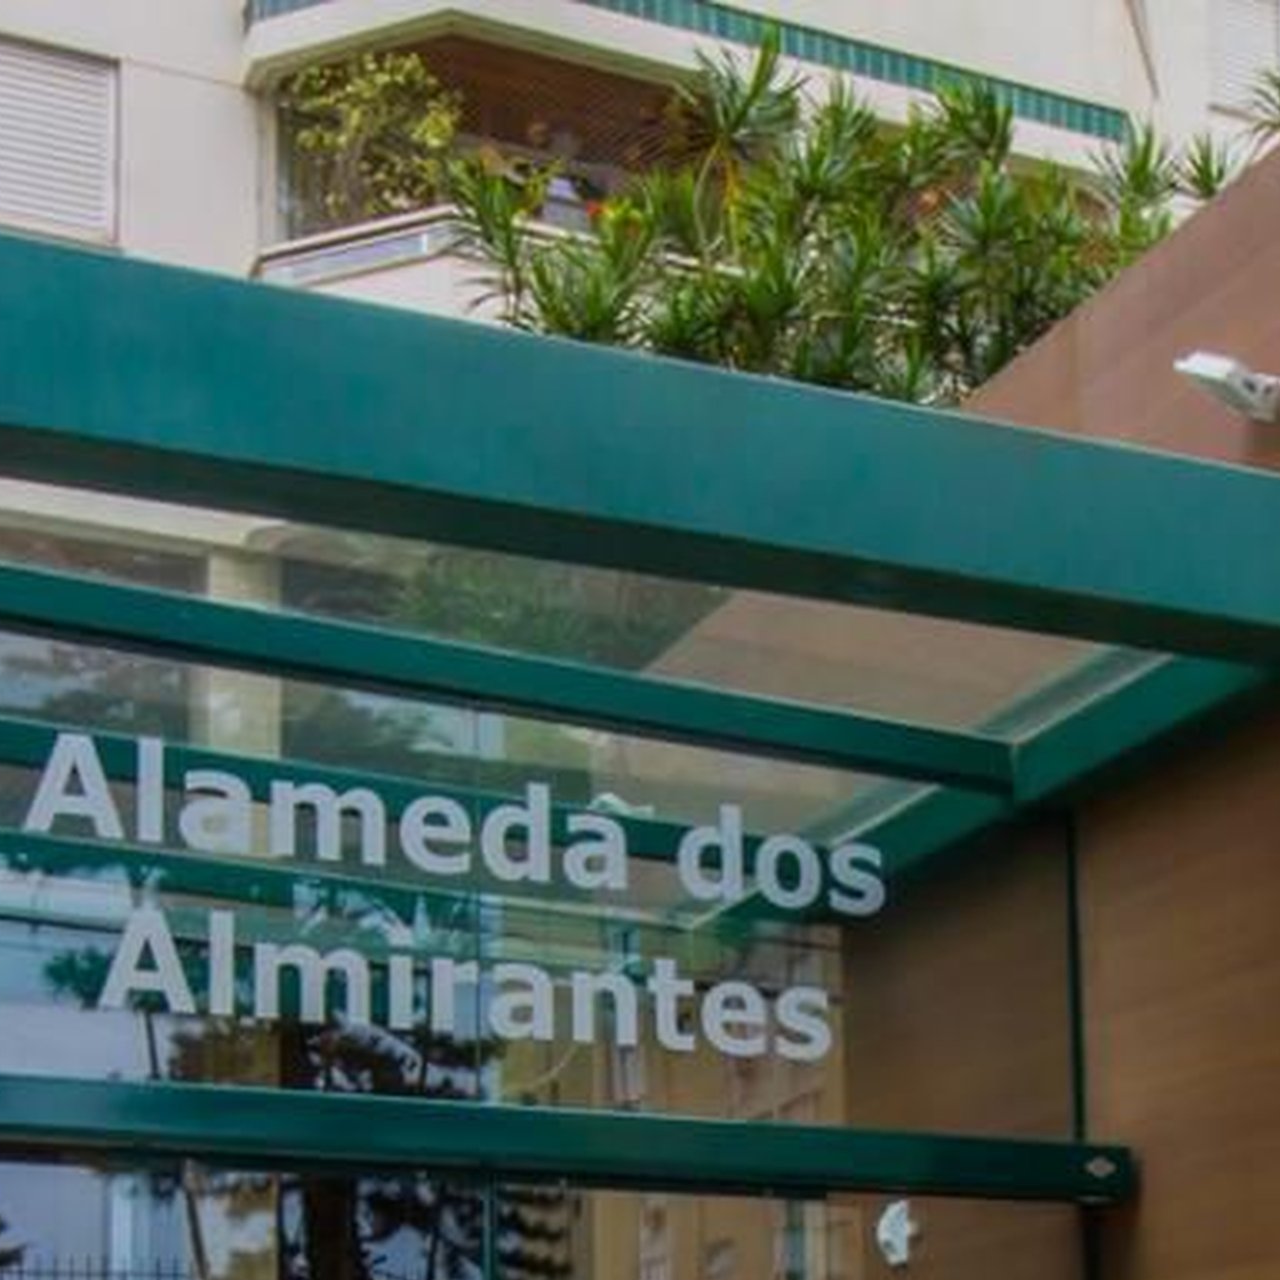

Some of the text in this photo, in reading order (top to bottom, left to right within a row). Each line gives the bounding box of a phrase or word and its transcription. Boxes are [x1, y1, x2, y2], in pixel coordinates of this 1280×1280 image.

[21, 732, 887, 916] Alameda dos
[98, 909, 833, 1064] Almirantes
